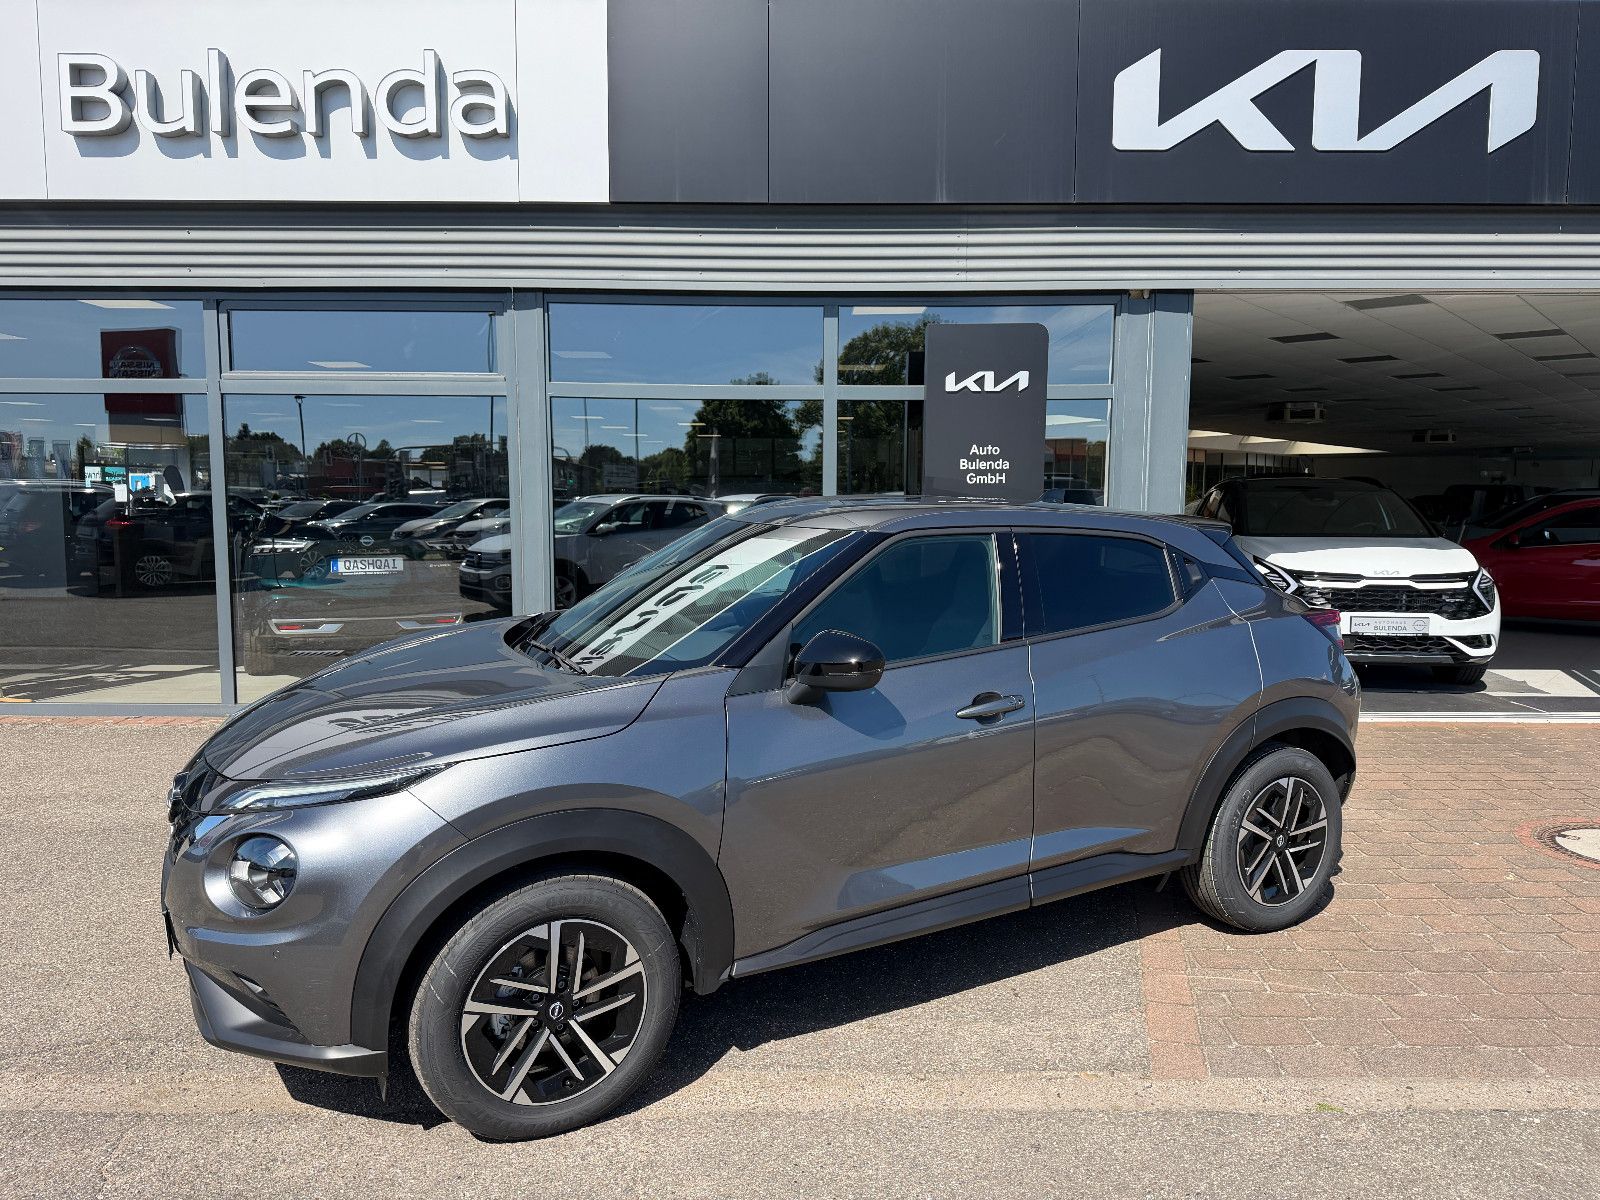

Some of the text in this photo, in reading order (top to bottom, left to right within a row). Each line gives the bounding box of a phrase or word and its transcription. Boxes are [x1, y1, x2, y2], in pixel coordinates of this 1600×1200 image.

[57, 48, 512, 138] Bulenda
[1112, 48, 1541, 154] KIA
[945, 370, 1030, 392] KIA
[969, 444, 1001, 456] Auto
[959, 458, 1010, 470] Bulenda
[966, 472, 1006, 484] GmbH
[343, 558, 398, 570] QASHQAI
